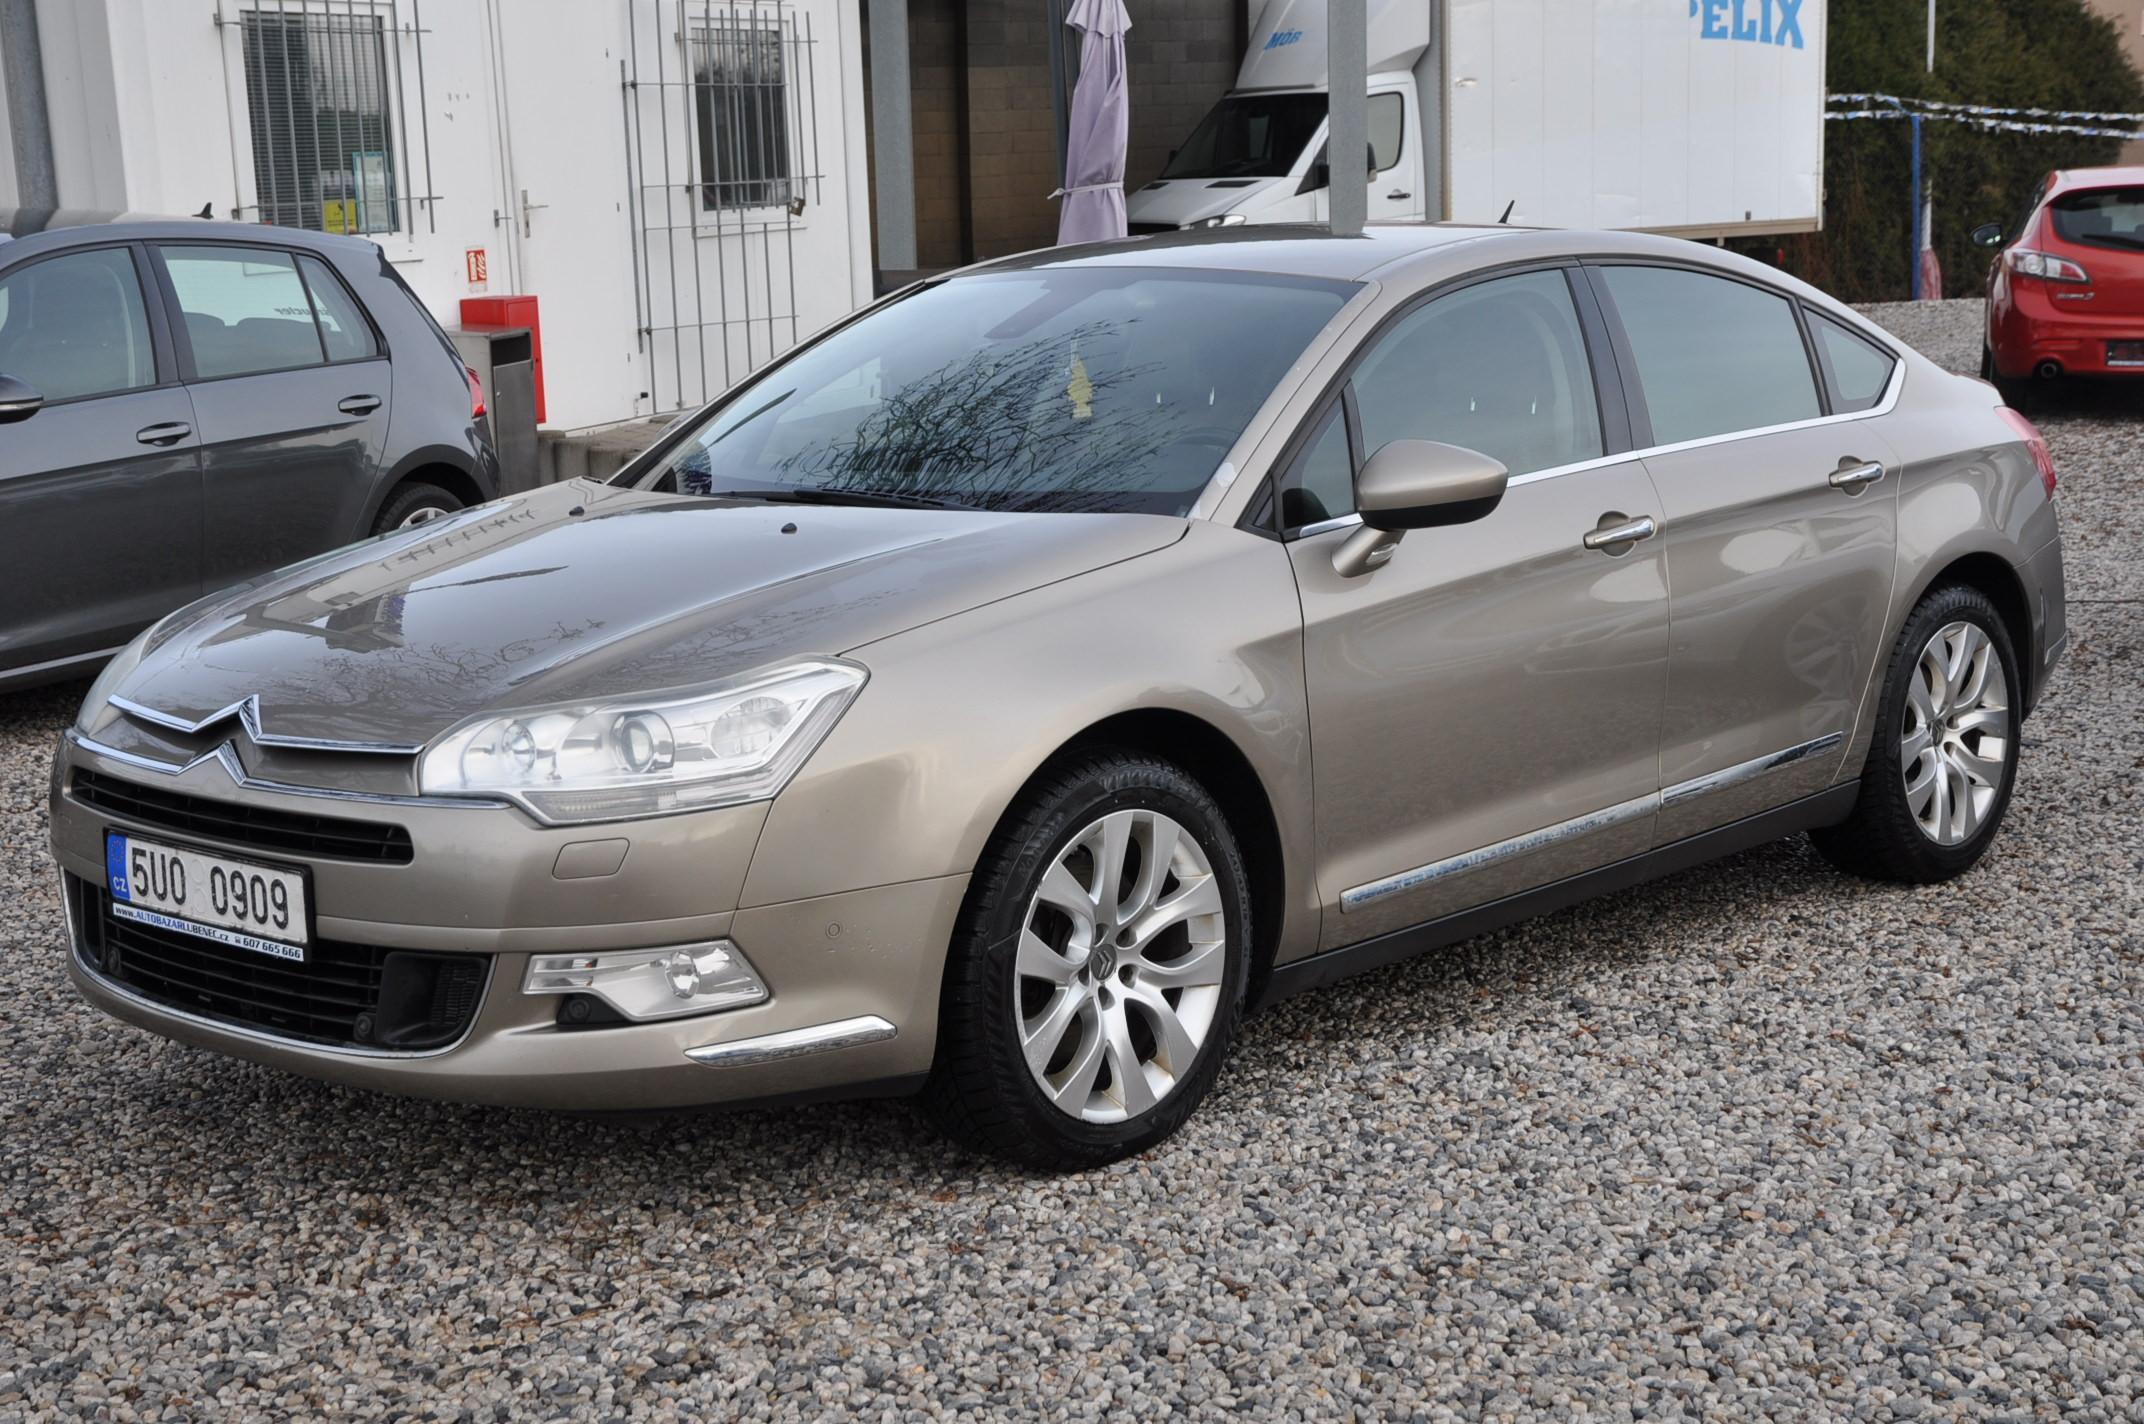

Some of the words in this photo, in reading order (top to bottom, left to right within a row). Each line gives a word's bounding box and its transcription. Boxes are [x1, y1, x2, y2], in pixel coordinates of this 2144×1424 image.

[1689, 0, 1804, 50] ELIX
[112, 876, 128, 893] CZ
[210, 866, 289, 930] 0909
[243, 937, 260, 949] 607
[262, 941, 280, 954] 665
[282, 945, 301, 959] 666
